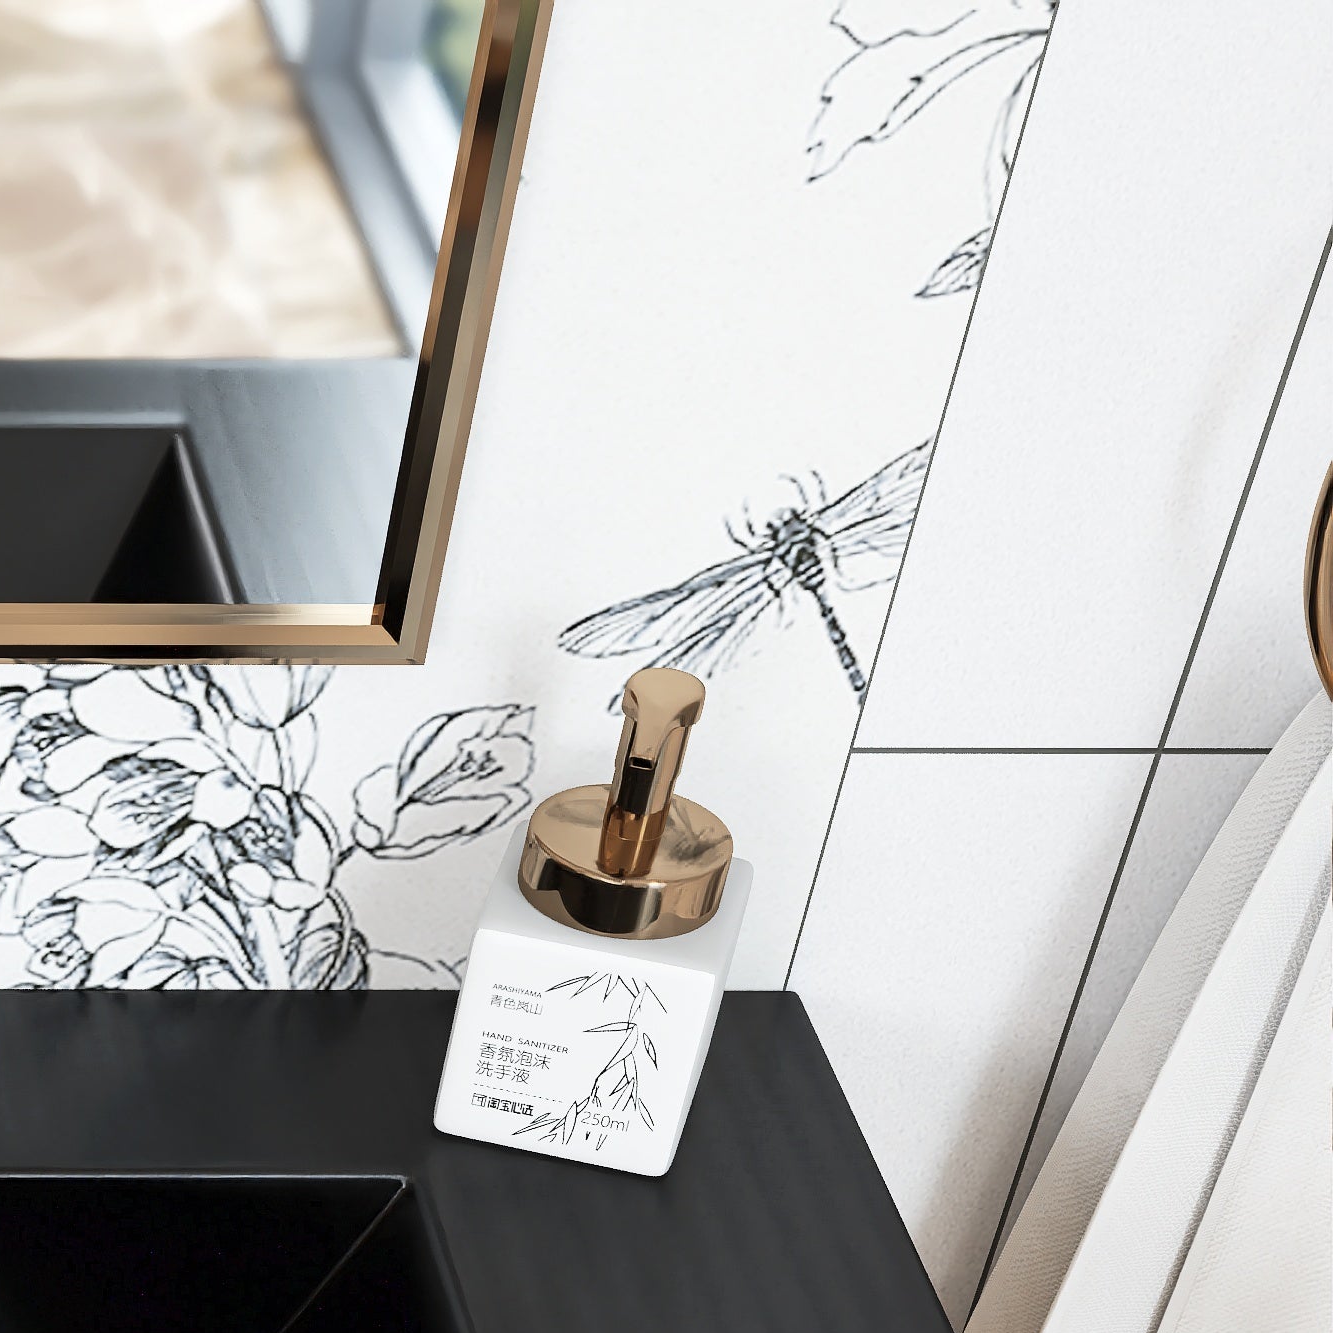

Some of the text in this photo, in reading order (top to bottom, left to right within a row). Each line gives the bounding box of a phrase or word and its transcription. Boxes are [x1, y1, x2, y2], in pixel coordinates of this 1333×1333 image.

[492, 983, 542, 999] ARASHIYAMA
[482, 1030, 569, 1055] HAND SANITIZER
[479, 1042, 552, 1070] 香氛泡沫
[475, 1059, 531, 1085] 洗手液
[580, 1111, 630, 1132] 250ml
